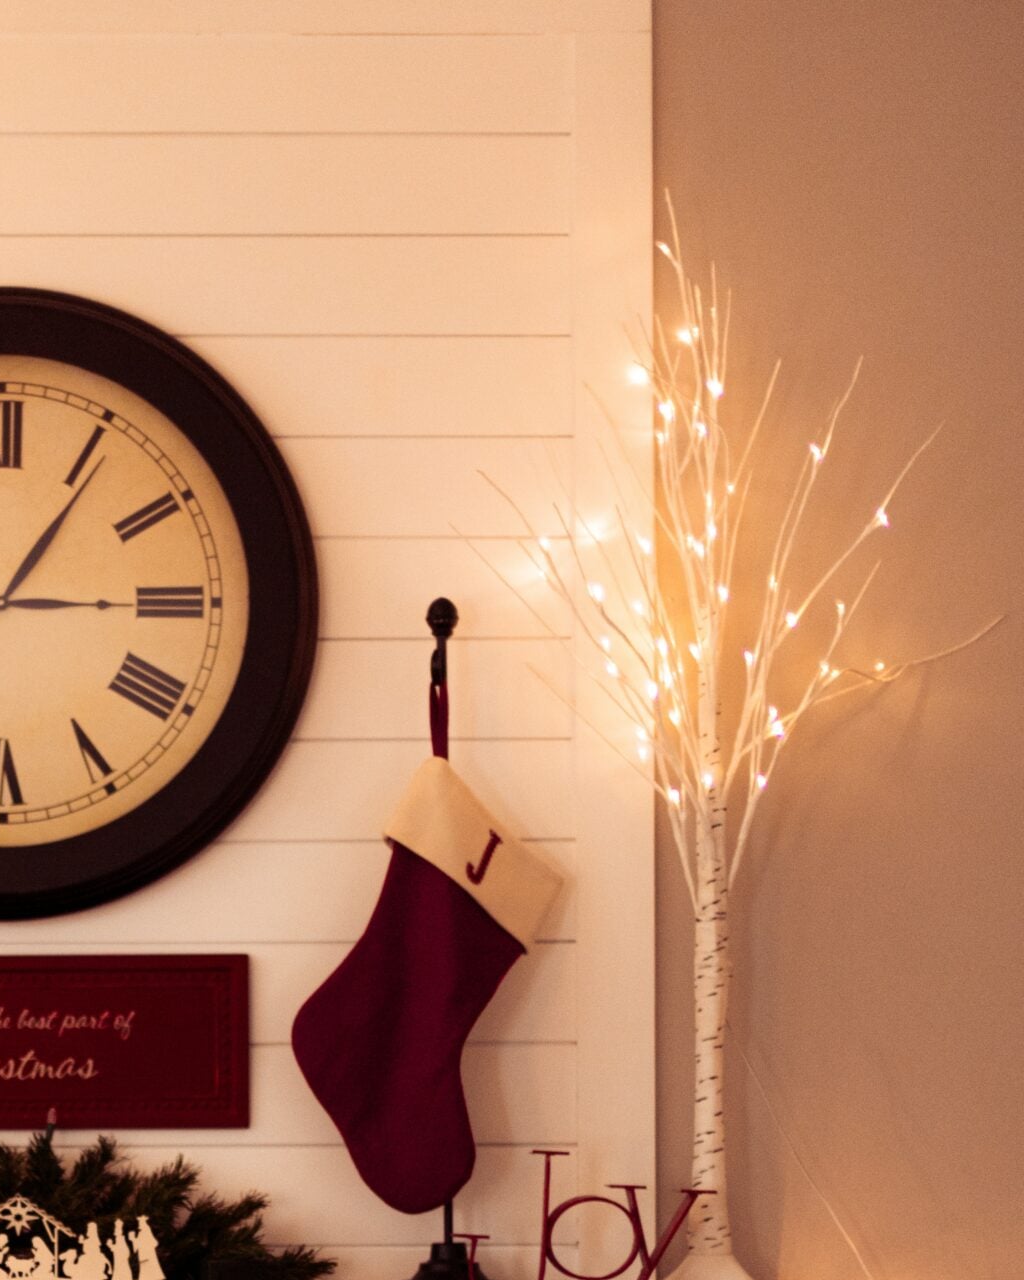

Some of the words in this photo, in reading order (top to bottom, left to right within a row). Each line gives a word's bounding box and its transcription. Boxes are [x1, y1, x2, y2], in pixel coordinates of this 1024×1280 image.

[65, 424, 107, 487] I
[112, 490, 183, 544] II
[135, 585, 205, 619] III
[107, 650, 188, 723] IIII
[70, 716, 117, 785] V
[465, 828, 504, 885] J
[16, 1008, 58, 1031] best
[59, 1010, 111, 1038] part
[112, 1010, 136, 1040] of
